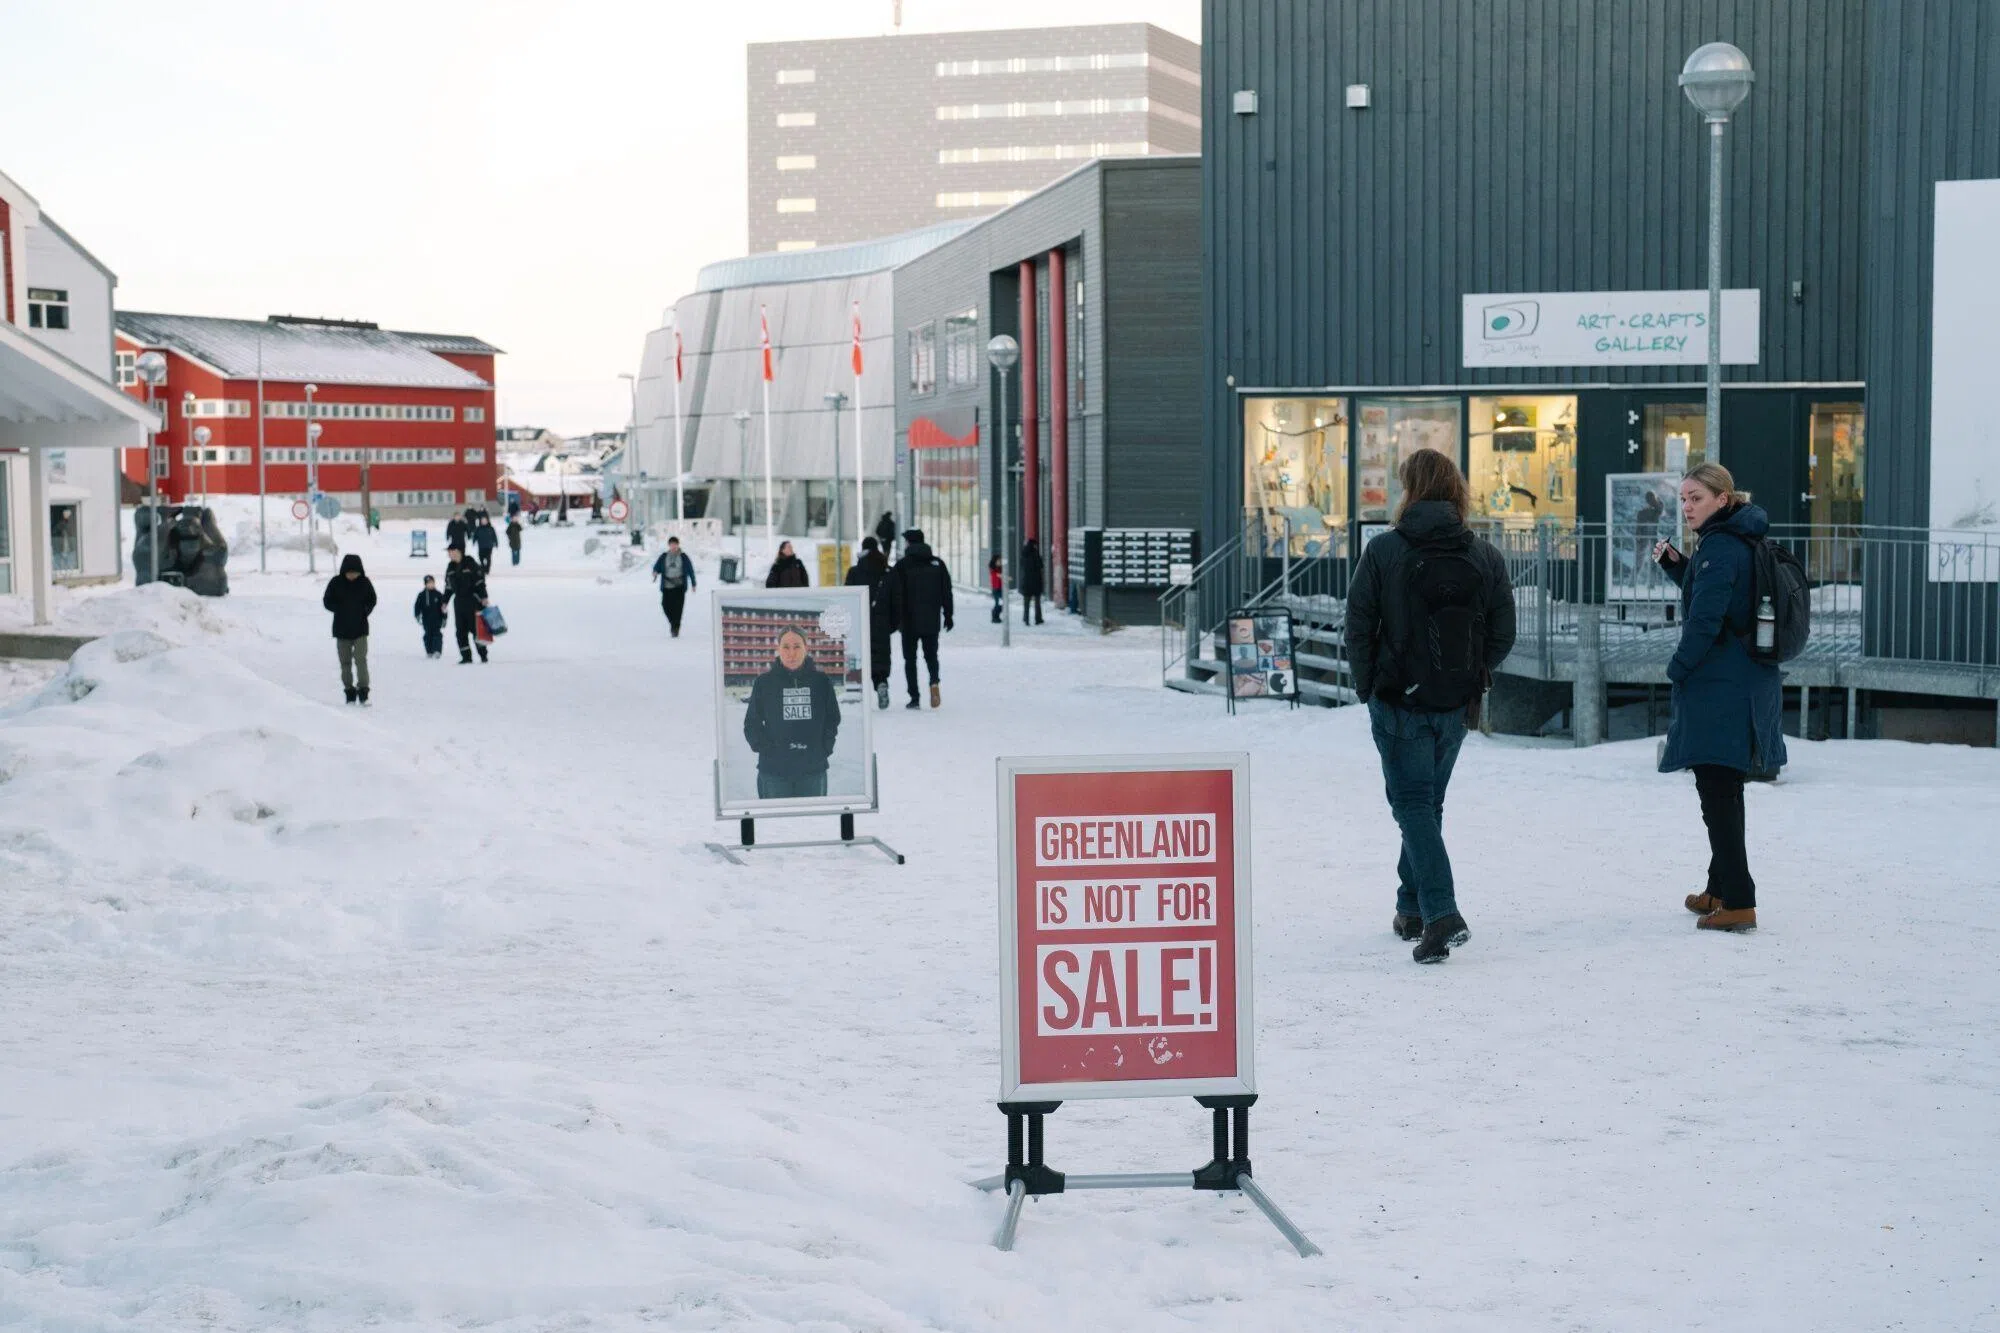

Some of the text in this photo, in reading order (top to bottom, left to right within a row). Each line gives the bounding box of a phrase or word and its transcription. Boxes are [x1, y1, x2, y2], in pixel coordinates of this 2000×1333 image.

[1629, 312, 1706, 329] CRAFTS
[1595, 335, 1688, 352] GALLERY
[1041, 820, 1211, 860] GREENLAND
[1042, 883, 1211, 924] IS NOT FOR
[1042, 947, 1212, 1030] SALE!
